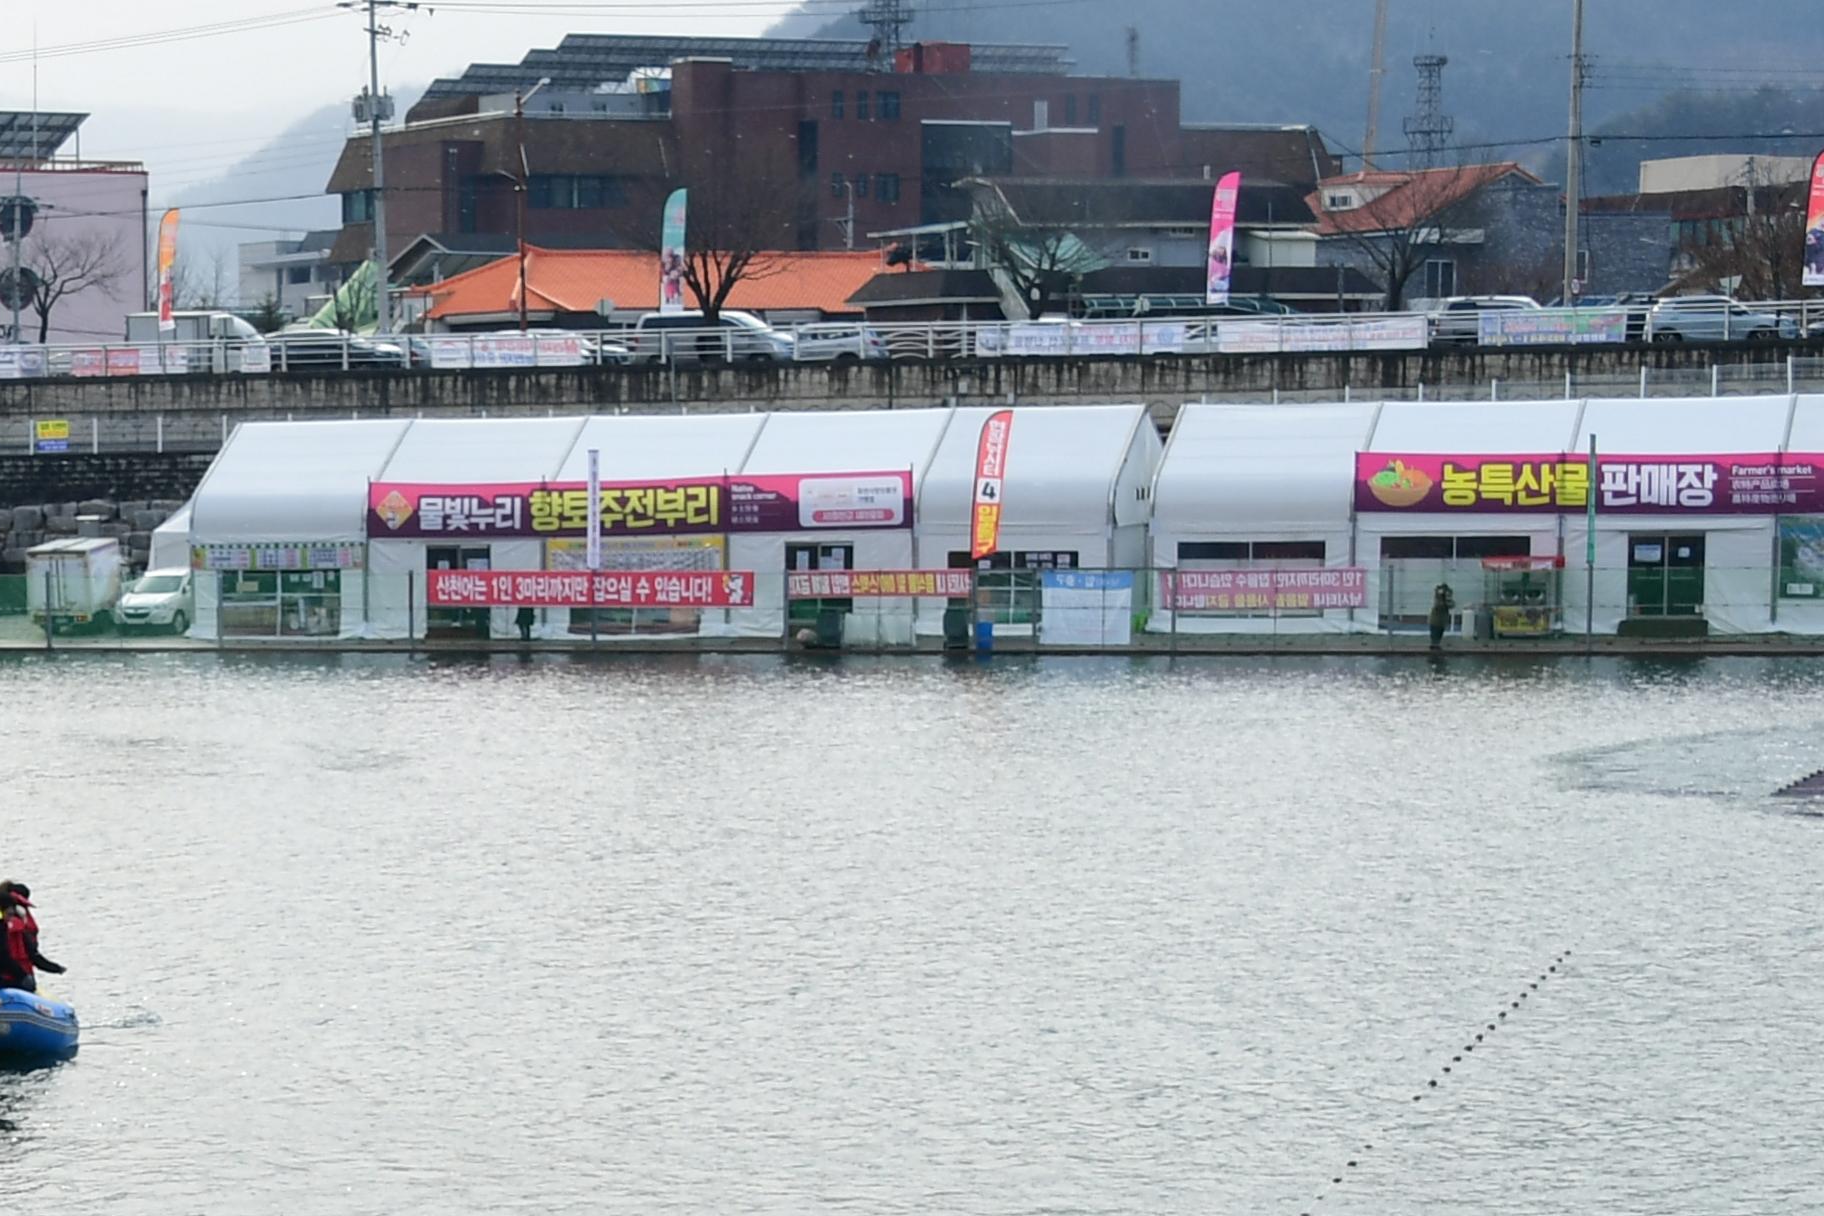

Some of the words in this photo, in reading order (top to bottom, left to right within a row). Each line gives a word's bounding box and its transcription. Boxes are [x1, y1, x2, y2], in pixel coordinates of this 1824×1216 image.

[1731, 465, 1775, 476] Farmer's
[980, 481, 997, 499] 4
[1441, 462, 1589, 506] 농특산물
[1601, 462, 1718, 507] 판매장
[418, 496, 522, 531] 물빛누리
[528, 485, 720, 532] 향토주전부리
[436, 575, 487, 601] 산천어는
[492, 576, 512, 601] 1인
[515, 575, 588, 602] 3마리까지만
[592, 576, 632, 602] 잡으실
[635, 576, 651, 602] 수
[655, 576, 713, 602] 있습니다!
